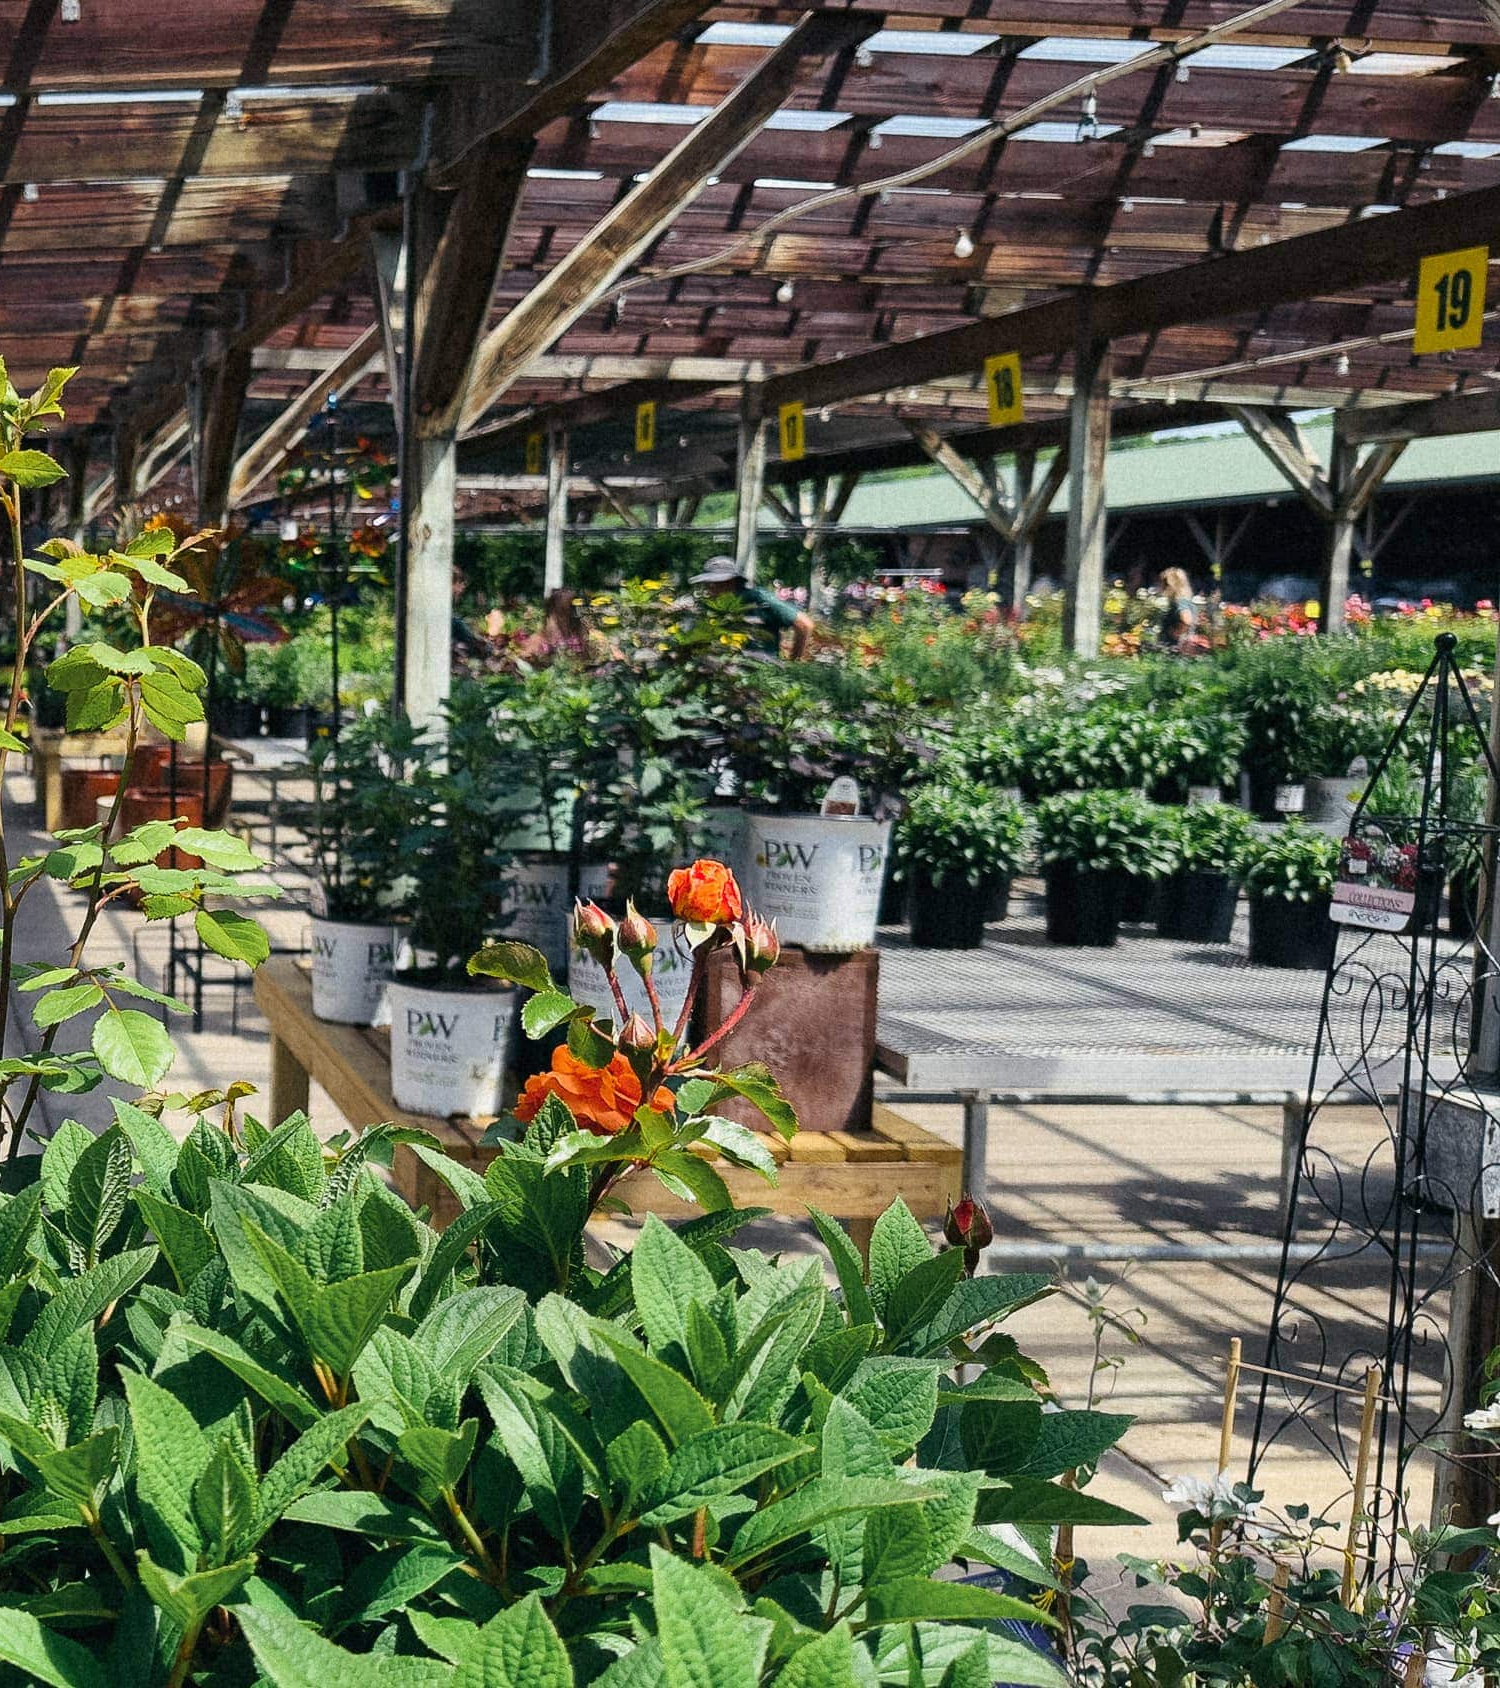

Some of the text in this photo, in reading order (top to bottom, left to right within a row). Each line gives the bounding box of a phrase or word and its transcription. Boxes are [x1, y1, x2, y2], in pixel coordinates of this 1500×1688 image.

[1434, 269, 1472, 332] 19
[764, 839, 820, 871] PW
[407, 1008, 460, 1039] PW
